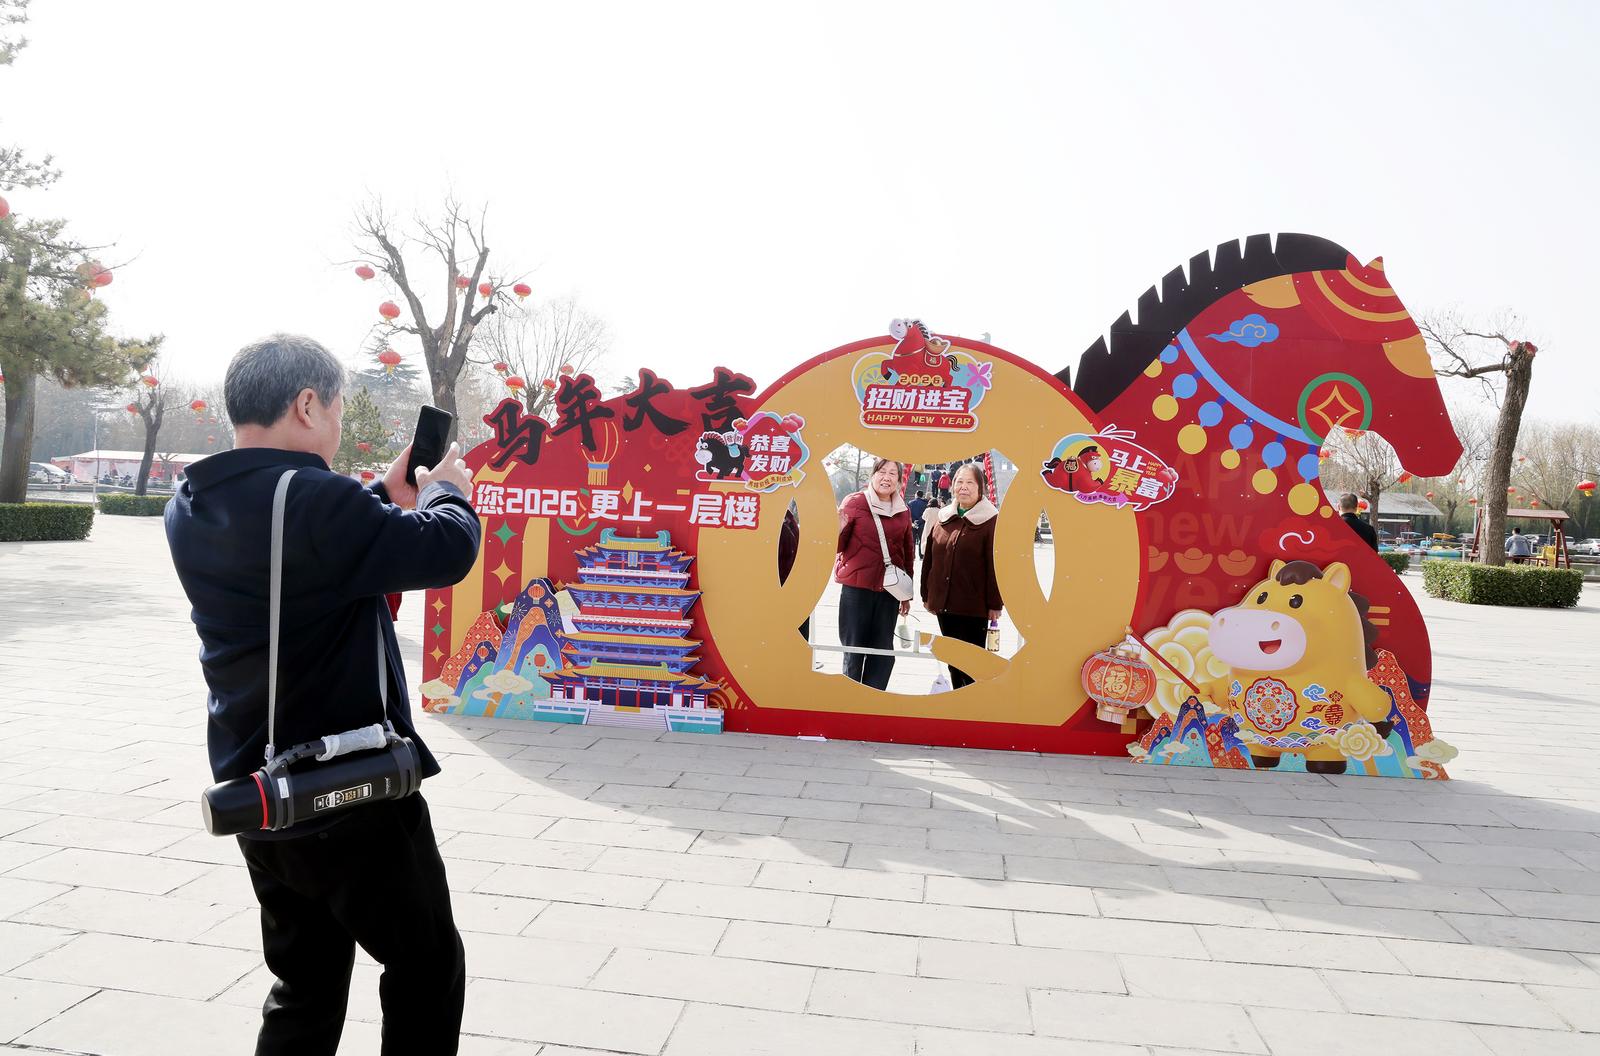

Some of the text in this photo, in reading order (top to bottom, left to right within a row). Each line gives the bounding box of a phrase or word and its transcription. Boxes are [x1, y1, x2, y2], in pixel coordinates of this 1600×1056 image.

[900, 374, 942, 385] 2026
[867, 388, 968, 411] 招财进宝
[488, 368, 754, 468] 马年大吉
[867, 414, 971, 425] HAPPY NEW YEAR
[750, 434, 791, 453] 恭喜
[749, 454, 791, 473] 发财
[1109, 449, 1147, 473] 马上
[1108, 468, 1163, 499] 暴富
[1104, 671, 1128, 694] 福
